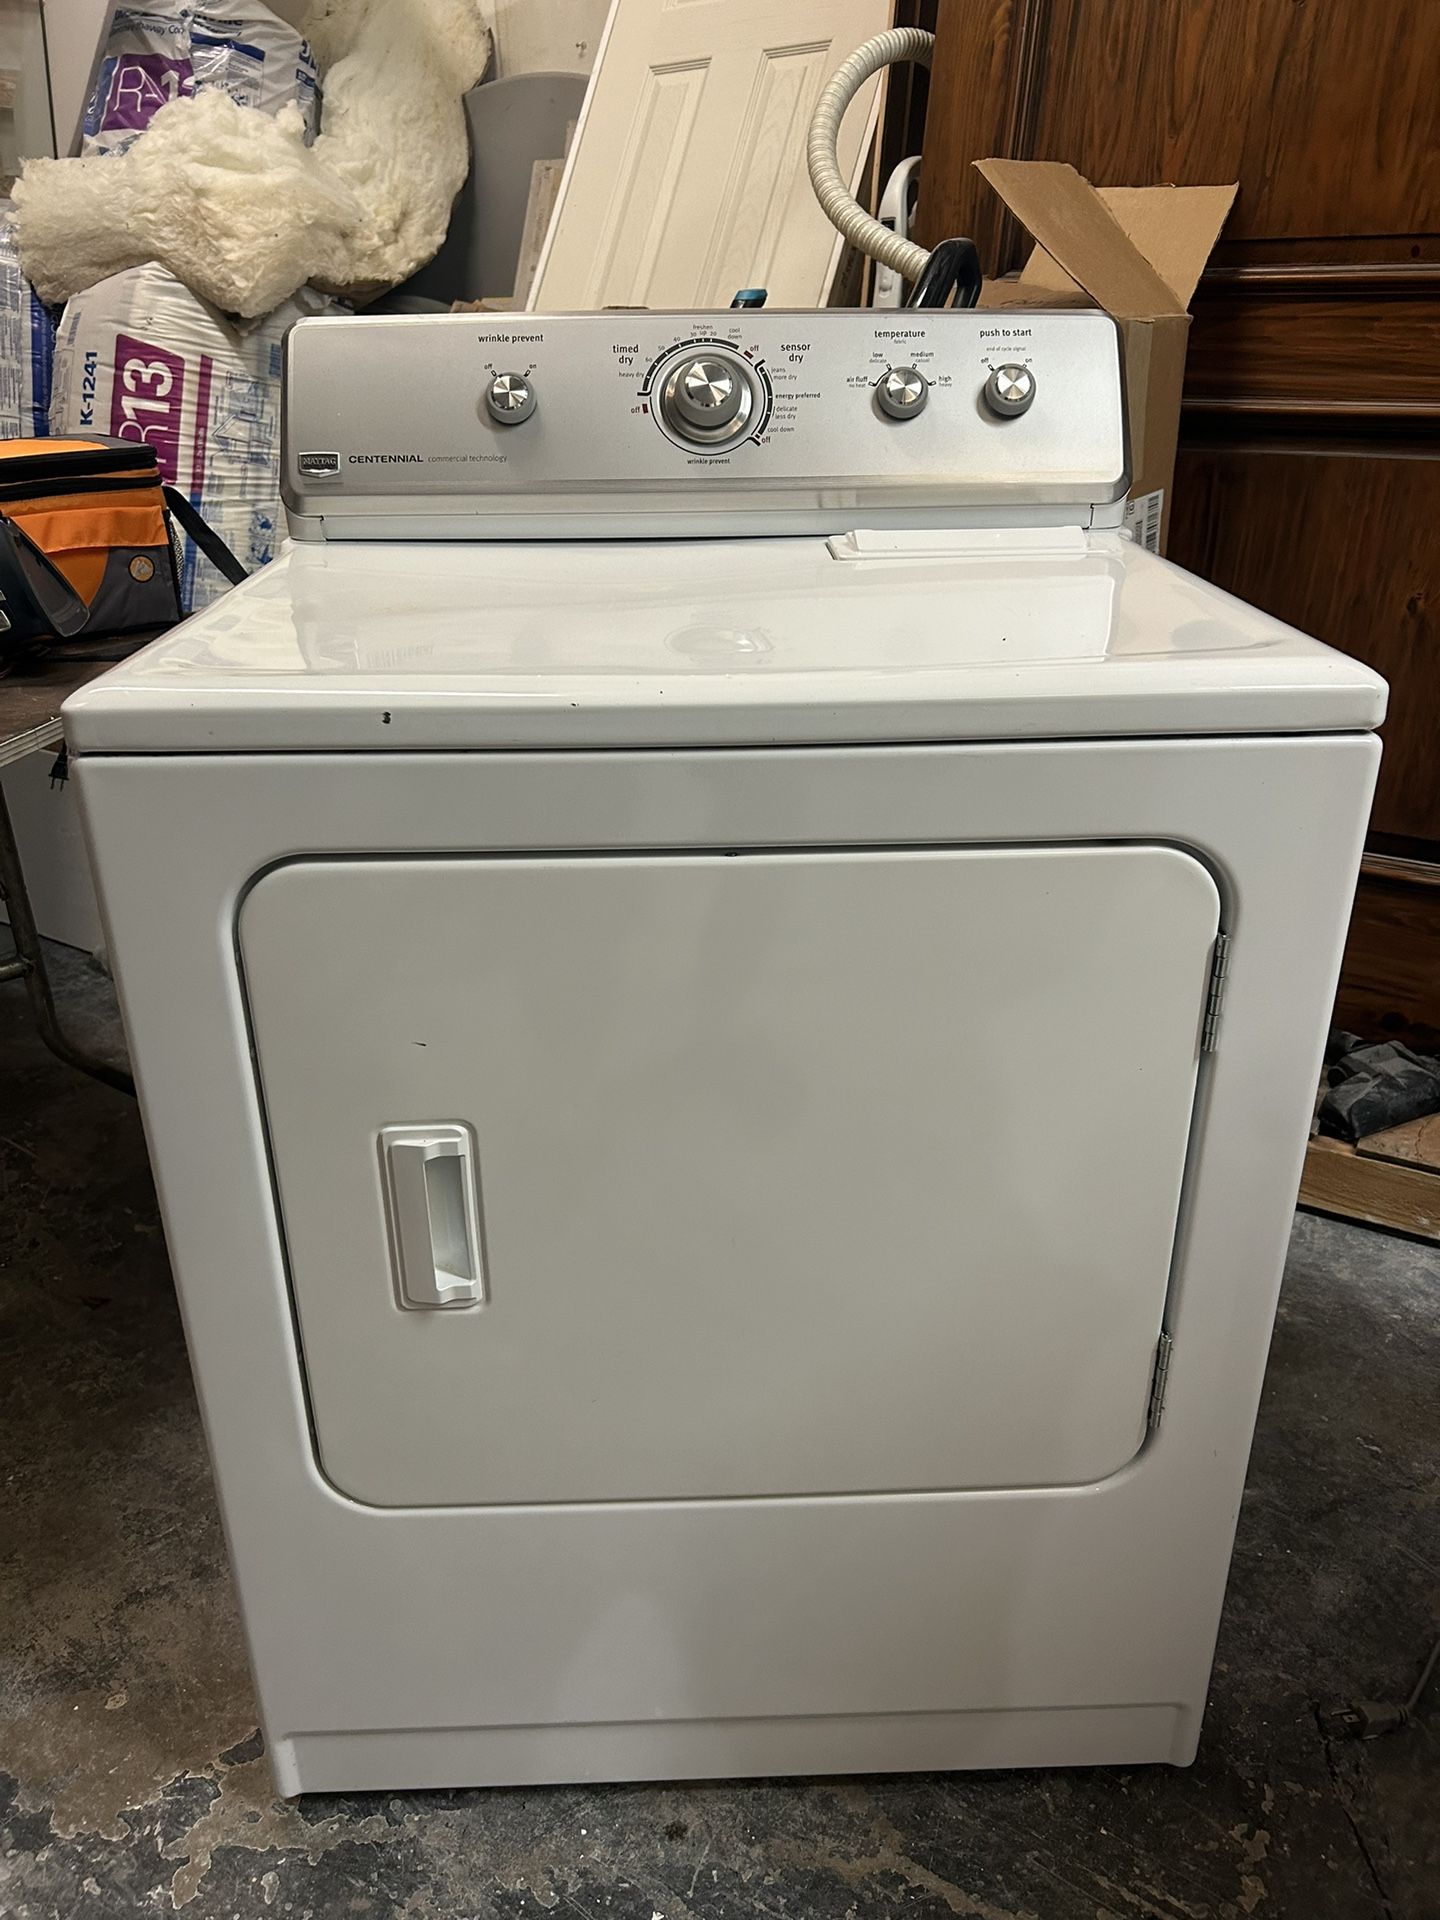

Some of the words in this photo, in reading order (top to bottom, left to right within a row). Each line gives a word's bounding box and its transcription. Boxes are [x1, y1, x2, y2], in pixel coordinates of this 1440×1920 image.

[874, 331, 926, 339] temperature
[980, 329, 1000, 338] push
[478, 334, 510, 342] wrinkle
[512, 334, 543, 344] prevent
[613, 344, 639, 353] timed
[619, 355, 634, 366] dry
[789, 353, 804, 364] dry
[80, 351, 98, 426] K-1241
[303, 456, 338, 466] MAYTAG
[348, 454, 424, 463] CENTENNIAL
[427, 454, 467, 462] commercial
[469, 454, 508, 463] technology
